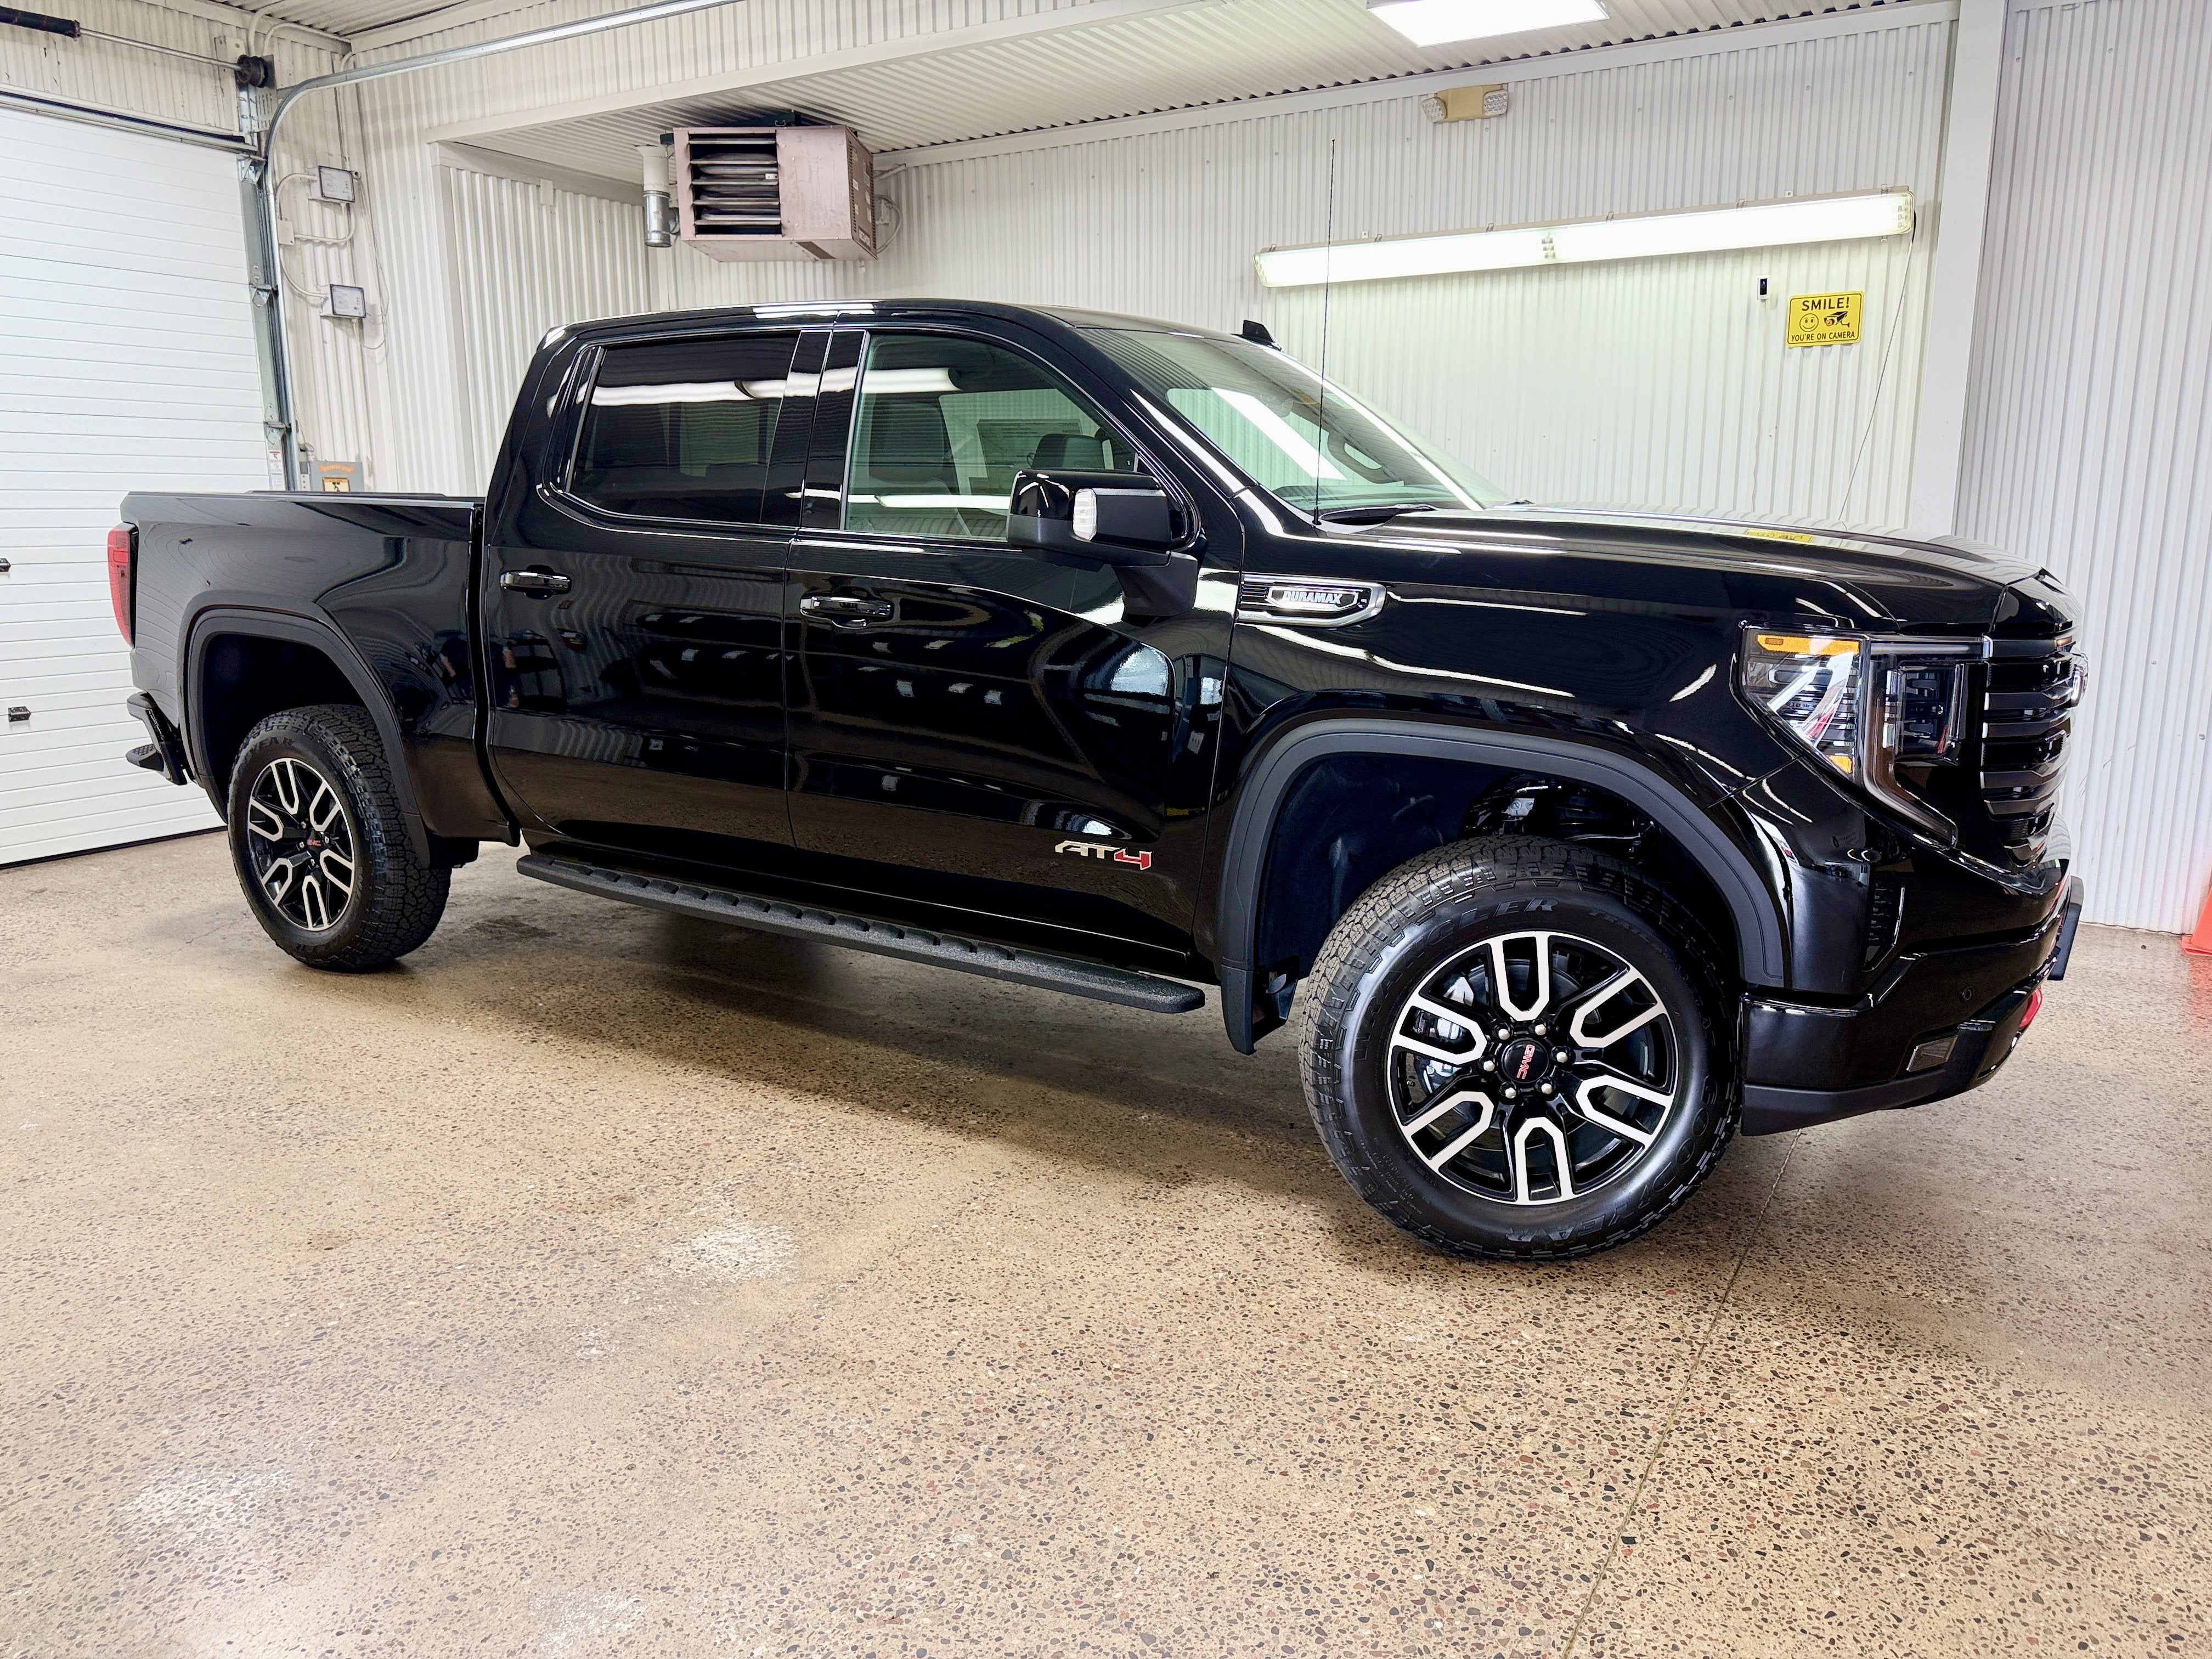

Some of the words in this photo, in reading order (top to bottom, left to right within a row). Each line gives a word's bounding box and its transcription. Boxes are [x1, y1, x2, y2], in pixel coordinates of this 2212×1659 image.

[1802, 297, 1849, 311] SMILE!
[1791, 334, 1814, 342] YOU'RE
[1829, 331, 1855, 340] CAMERA
[1283, 591, 1343, 604] DURAMAX
[1055, 840, 1152, 871] AT4
[1516, 1043, 1536, 1080] GMC
[1505, 1075, 1718, 1242] GOODYEAR
